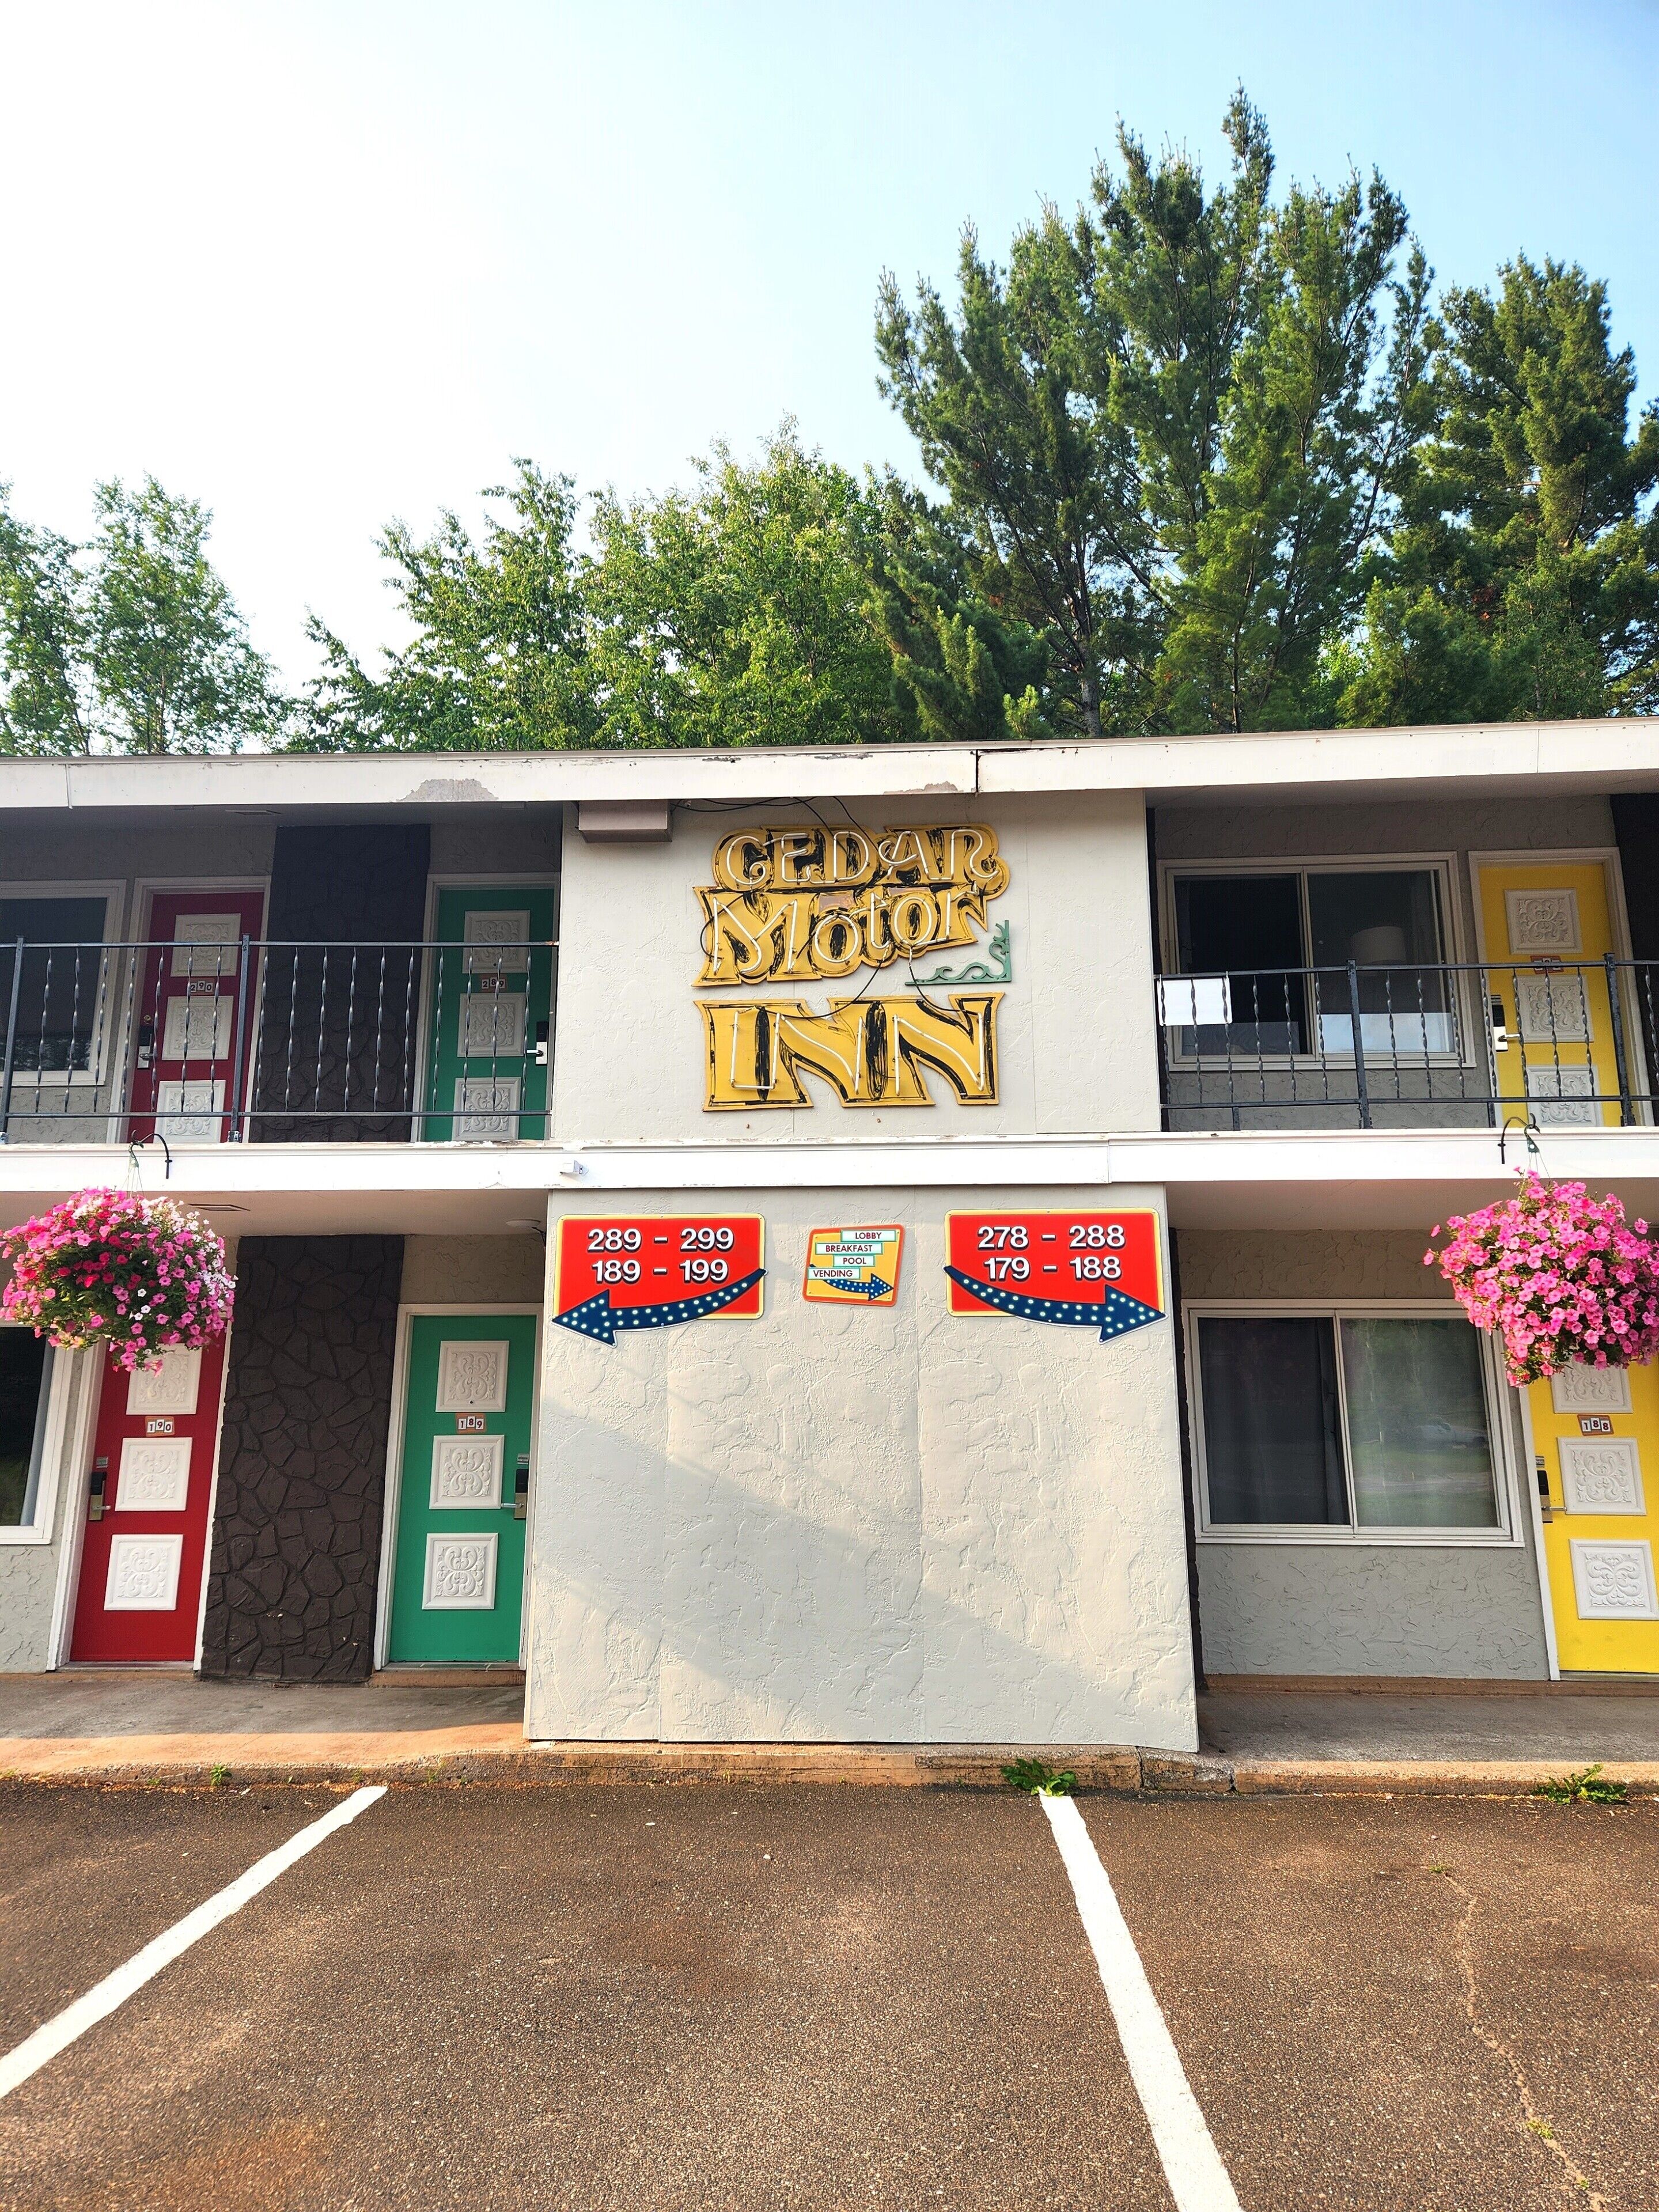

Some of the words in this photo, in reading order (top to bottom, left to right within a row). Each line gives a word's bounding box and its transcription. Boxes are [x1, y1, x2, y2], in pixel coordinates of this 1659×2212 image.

[713, 824, 1010, 897] CEDAR
[190, 982, 212, 991] 290
[483, 978, 504, 988] 289
[693, 993, 1005, 1112] INN
[587, 1228, 642, 1252] 289
[680, 1228, 733, 1251] 299
[978, 1225, 1029, 1249] 278
[1069, 1225, 1125, 1249] 288
[592, 1260, 641, 1283] 189
[679, 1259, 728, 1283] 199
[984, 1257, 1030, 1281] 179
[1070, 1256, 1121, 1280] 188
[149, 1421, 171, 1431] 190
[460, 1418, 483, 1429] 189
[1584, 1419, 1609, 1430] 188
